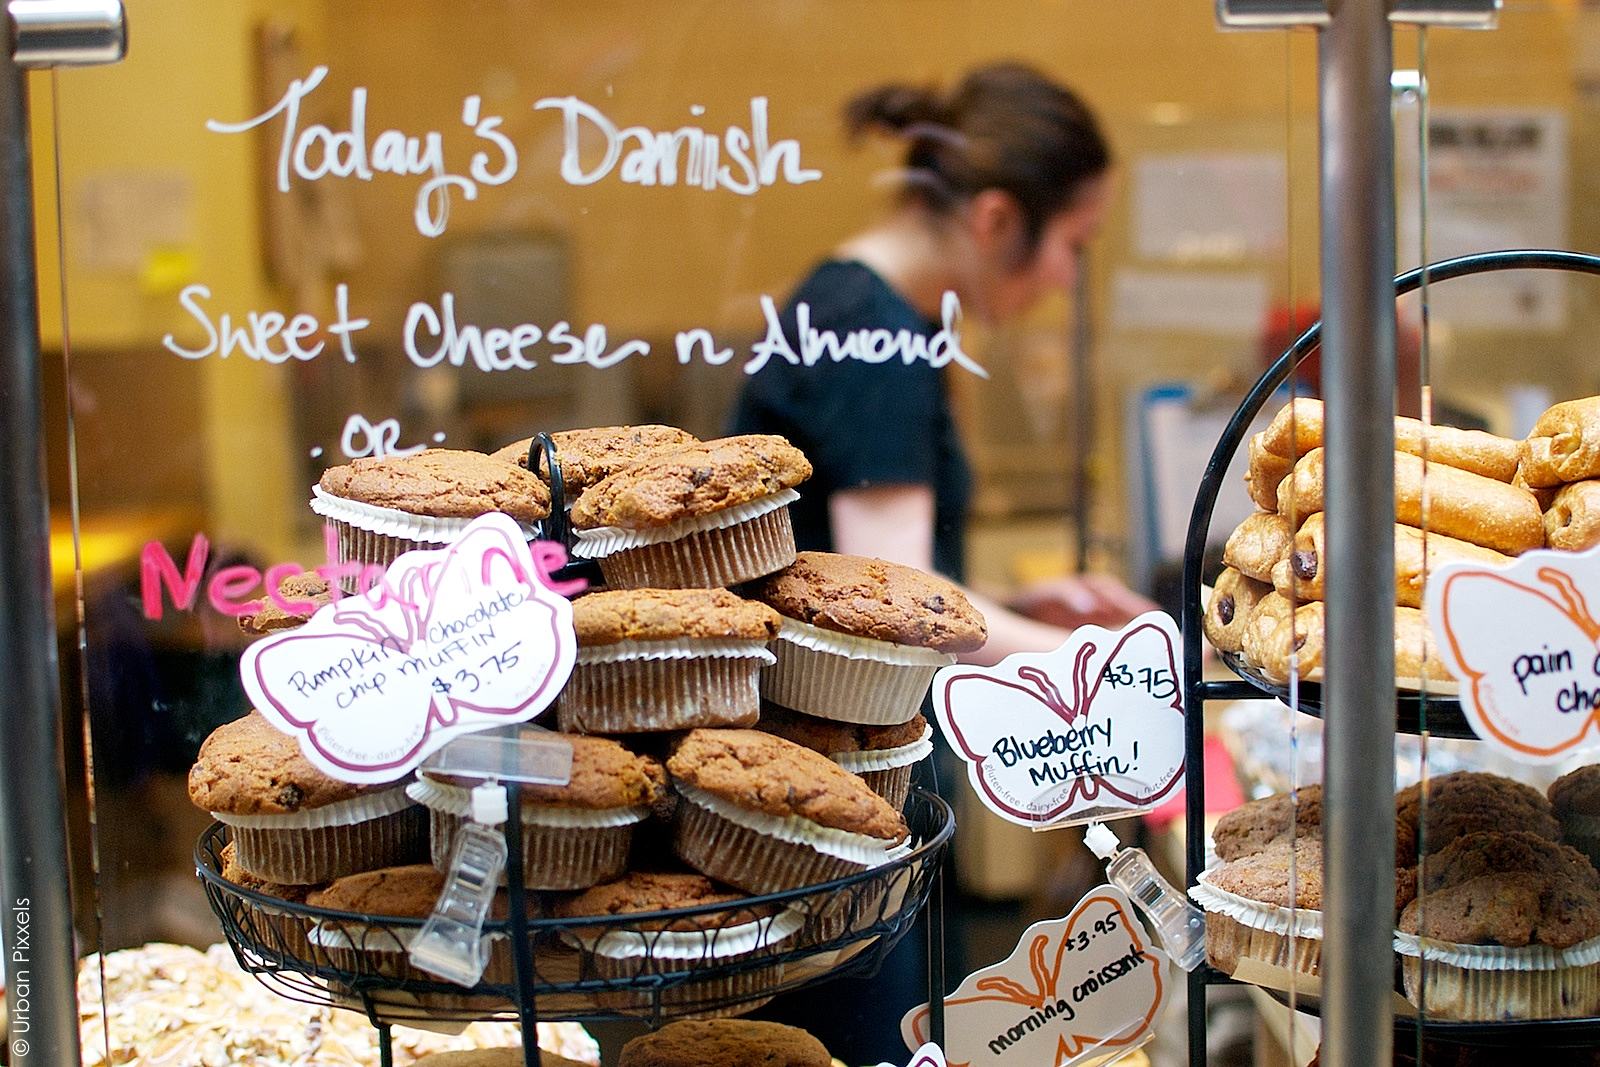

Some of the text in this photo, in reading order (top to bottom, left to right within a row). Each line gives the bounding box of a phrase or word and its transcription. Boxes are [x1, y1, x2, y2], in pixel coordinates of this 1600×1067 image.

[206, 65, 822, 237] Today's Danish
[163, 284, 370, 365] Sweet
[404, 291, 650, 372] Cheese
[743, 289, 990, 381] Almond
[287, 590, 525, 698] Pumpkin chocolate
[336, 671, 387, 709] chip
[1102, 663, 1178, 699] $3.75
[1512, 644, 1573, 696] pain
[992, 717, 1112, 768] Blueberry
[1028, 740, 1140, 787] Muffin!
[983, 763, 1021, 808] gluten-free
[1143, 765, 1176, 795] nut-free
[1064, 910, 1123, 952] $3.95
[987, 997, 1076, 1056] morning
